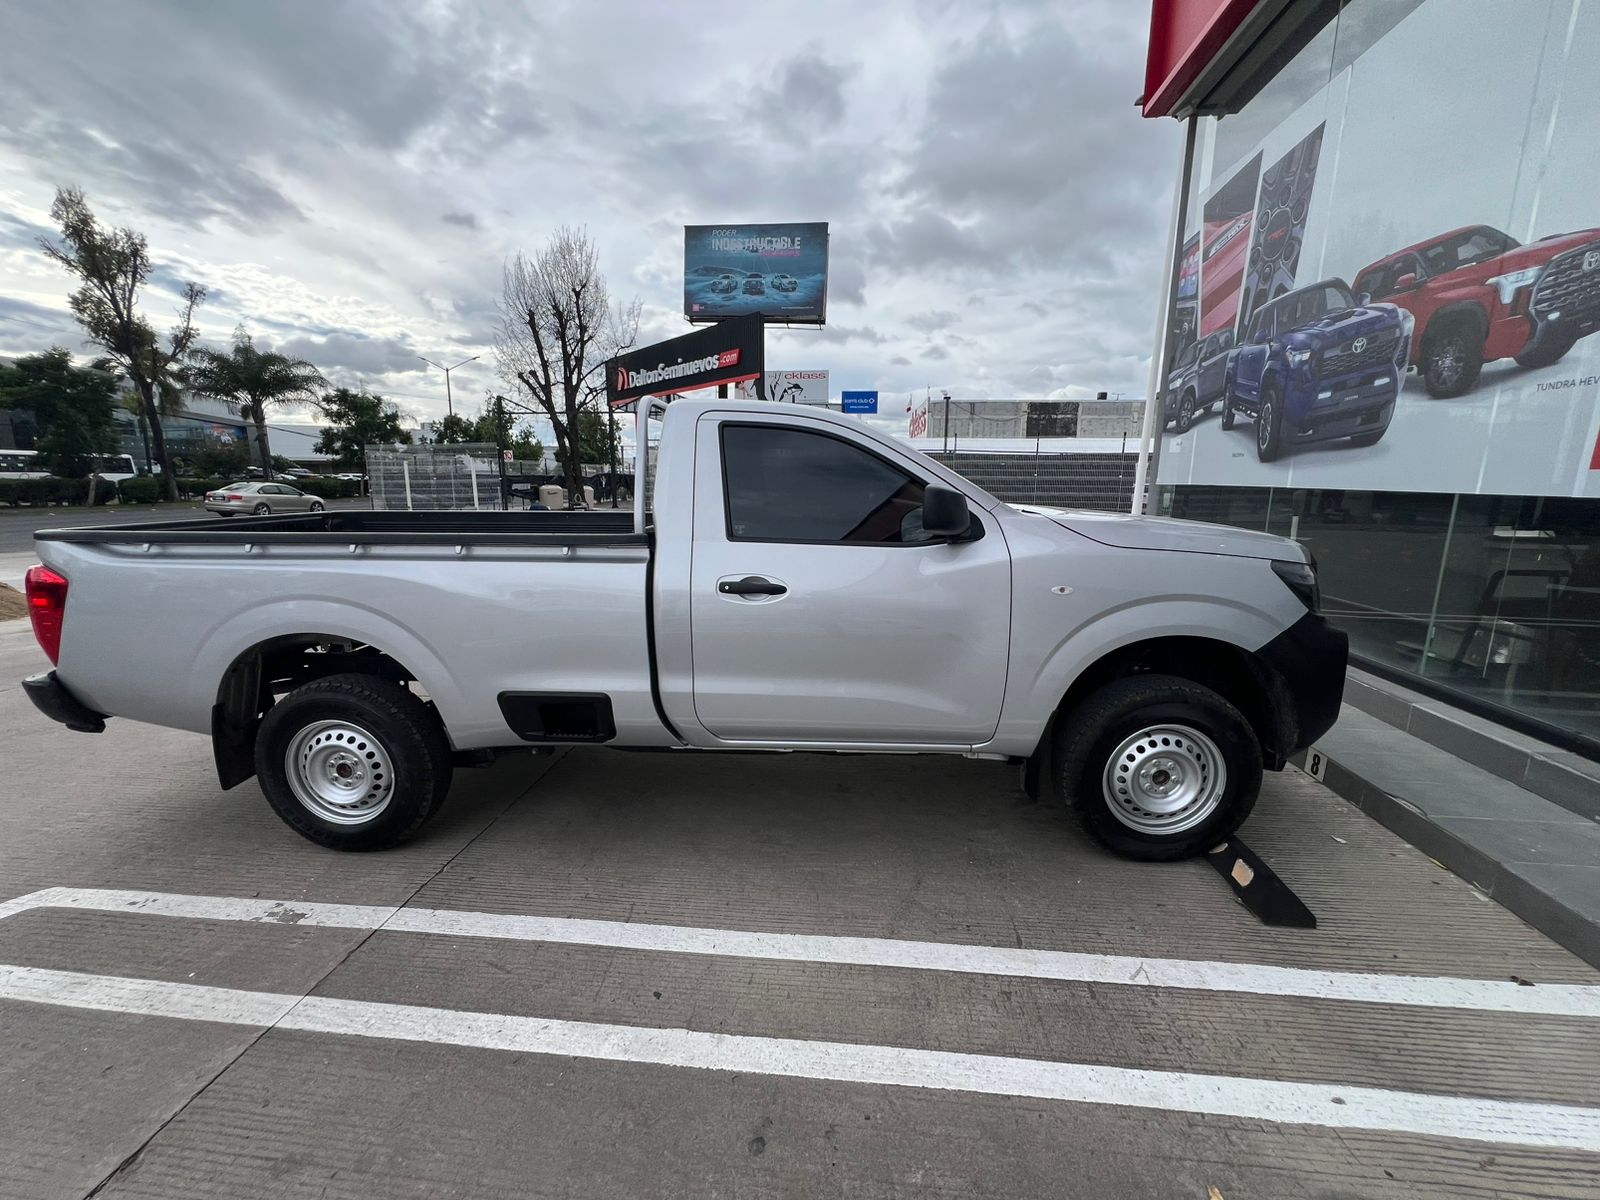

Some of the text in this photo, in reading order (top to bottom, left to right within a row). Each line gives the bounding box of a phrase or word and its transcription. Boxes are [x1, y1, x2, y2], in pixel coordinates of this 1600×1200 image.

[712, 229, 737, 237] PODER
[784, 371, 826, 380] cklass
[1536, 379, 1577, 392] TUNDRA
[1310, 753, 1321, 776] 8
